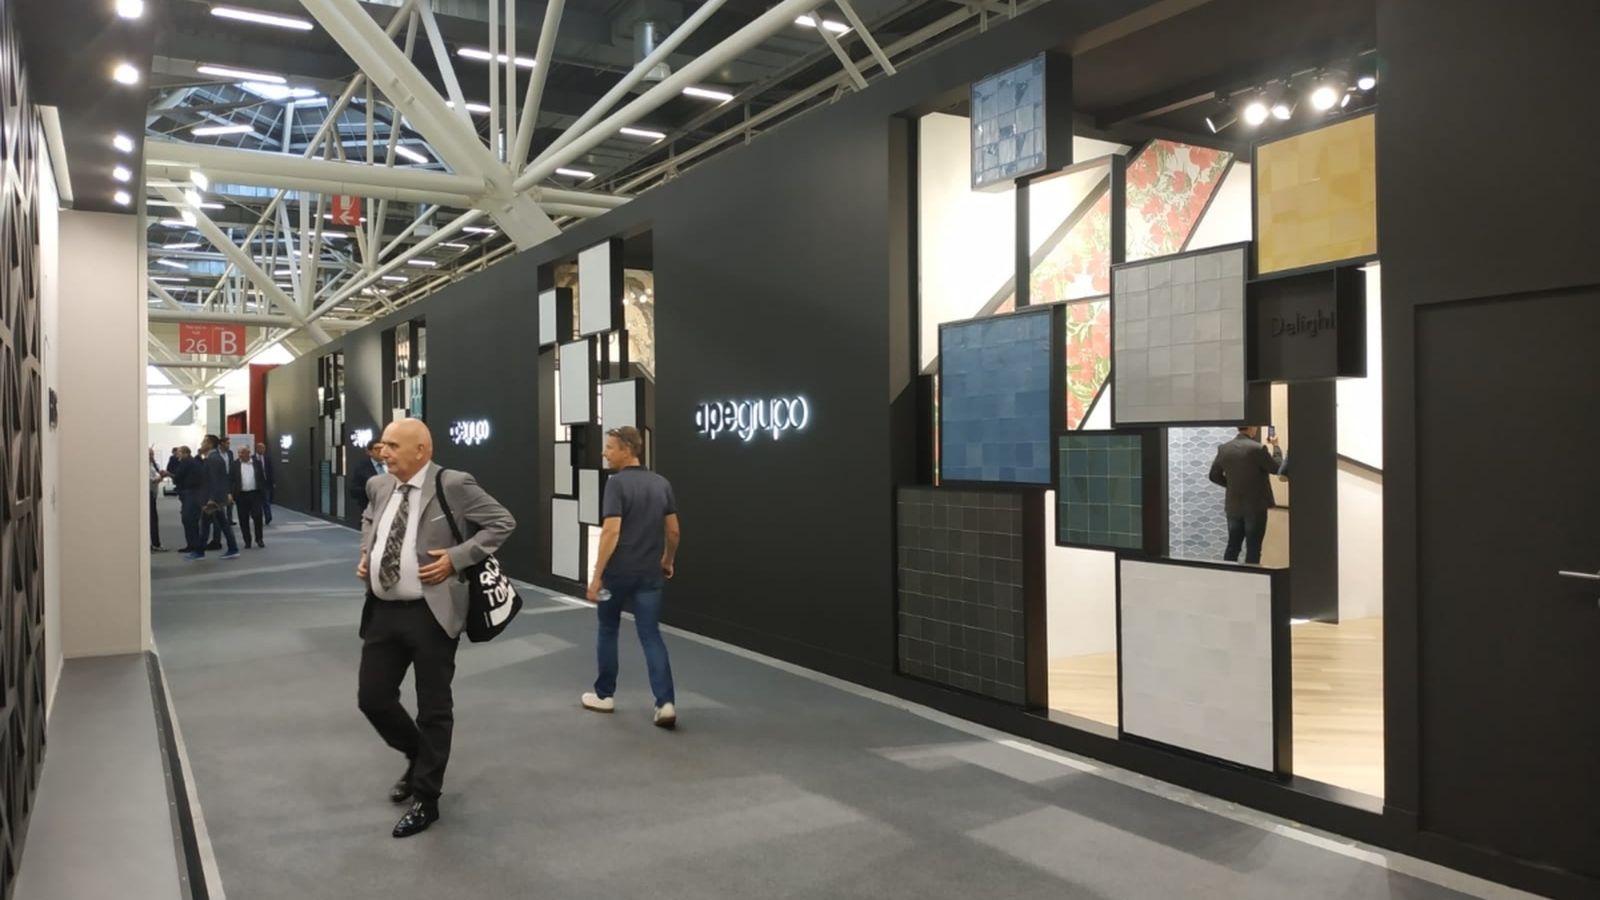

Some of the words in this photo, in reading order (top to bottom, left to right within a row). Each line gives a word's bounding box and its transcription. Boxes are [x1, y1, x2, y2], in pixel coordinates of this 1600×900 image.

[1271, 308, 1336, 338] Delight
[185, 338, 207, 353] 26
[220, 331, 238, 355] B
[695, 395, 809, 442] apegrupo
